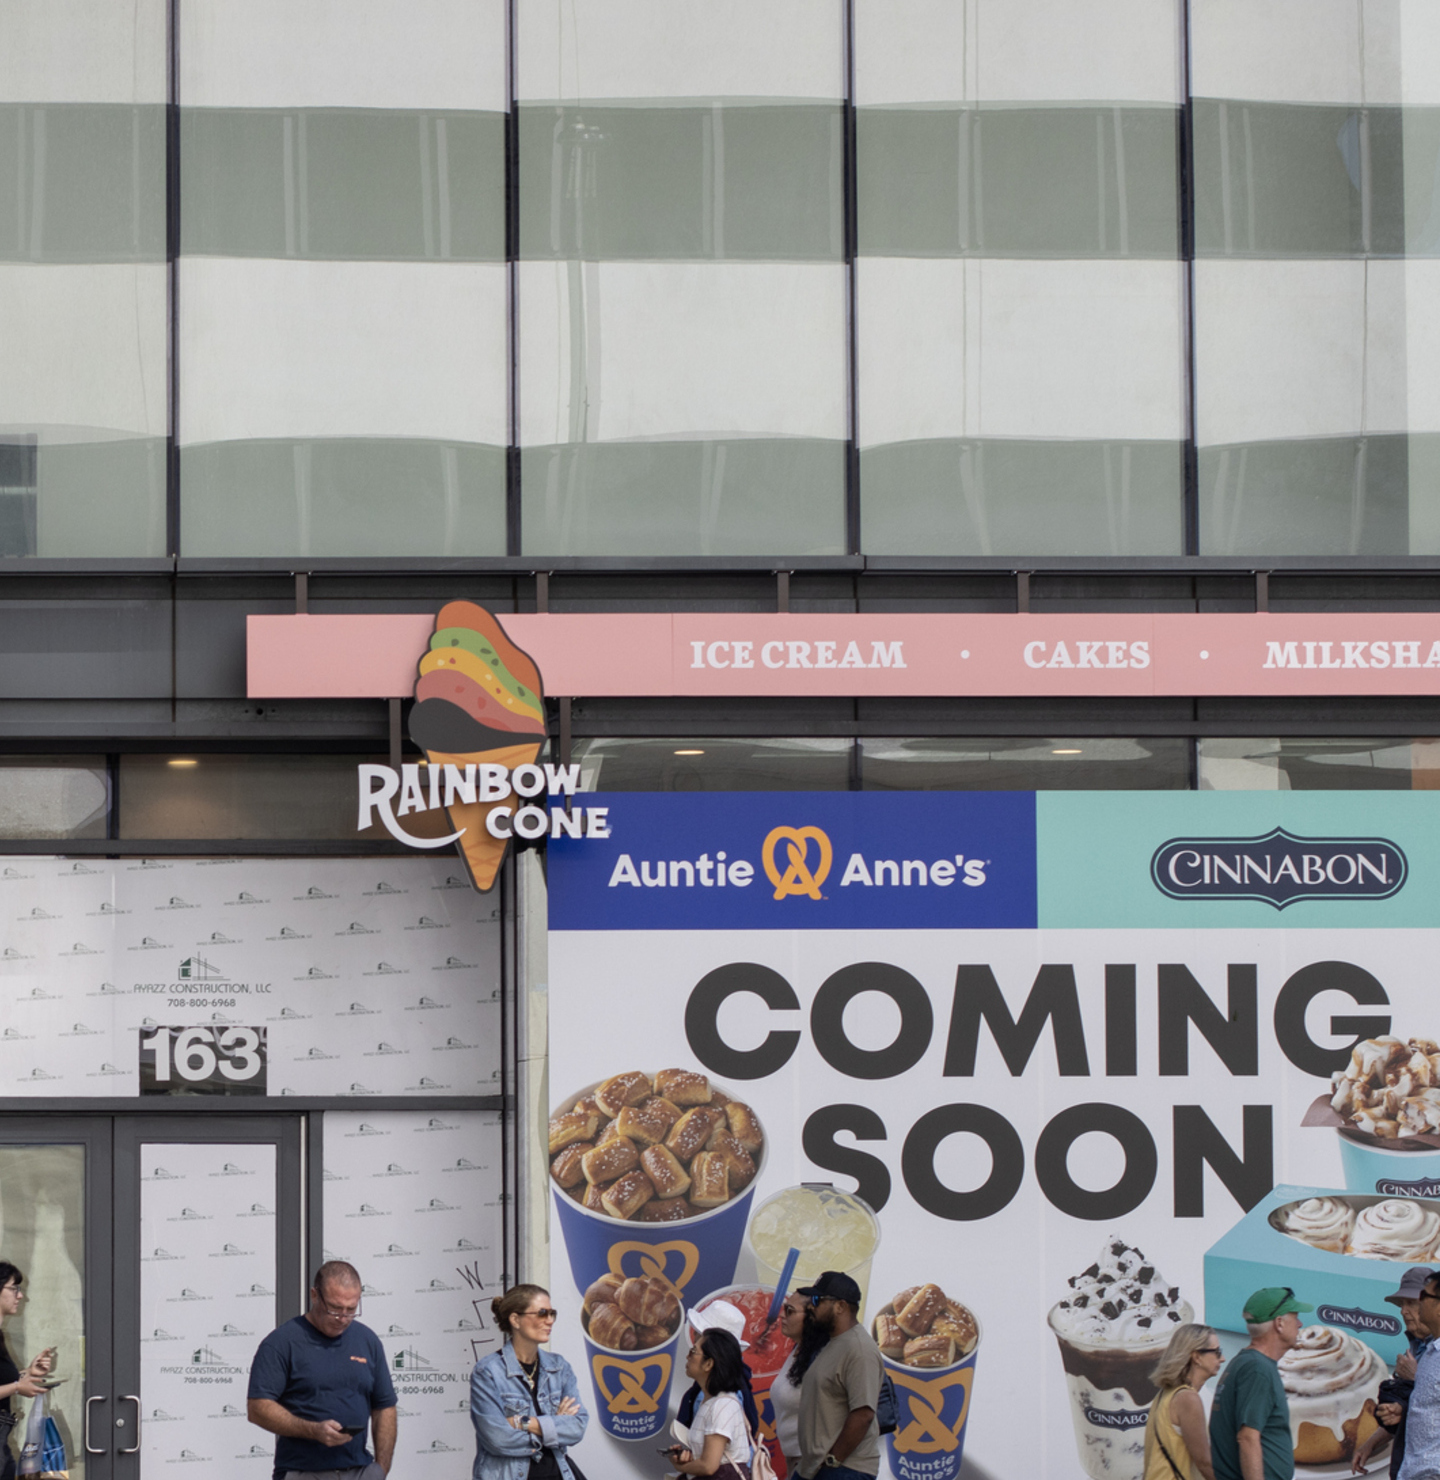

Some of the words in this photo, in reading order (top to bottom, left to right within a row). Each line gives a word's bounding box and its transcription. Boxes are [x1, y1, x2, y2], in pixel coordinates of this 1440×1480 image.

[690, 640, 755, 669] ICE
[761, 640, 907, 669] CREAM
[1023, 640, 1150, 669] CAKES
[357, 763, 581, 849] RAINBOW
[485, 805, 610, 839] CONE
[607, 851, 755, 888] Auntie
[839, 852, 987, 887] Anne's
[1167, 850, 1388, 887] CINNABON
[167, 998, 236, 1008] 708-800-6968
[169, 983, 253, 994] CONSTRUCTION,
[255, 983, 272, 993] LLC
[684, 960, 1392, 1081] COMING
[142, 1027, 262, 1082] 163
[801, 1102, 1275, 1222] SOON
[1322, 1308, 1396, 1332] CINNABON
[611, 1415, 656, 1426] Auntie
[613, 1423, 656, 1434] Anne's
[1087, 1410, 1149, 1425] CINNABO
[898, 1454, 955, 1471] Auntie
